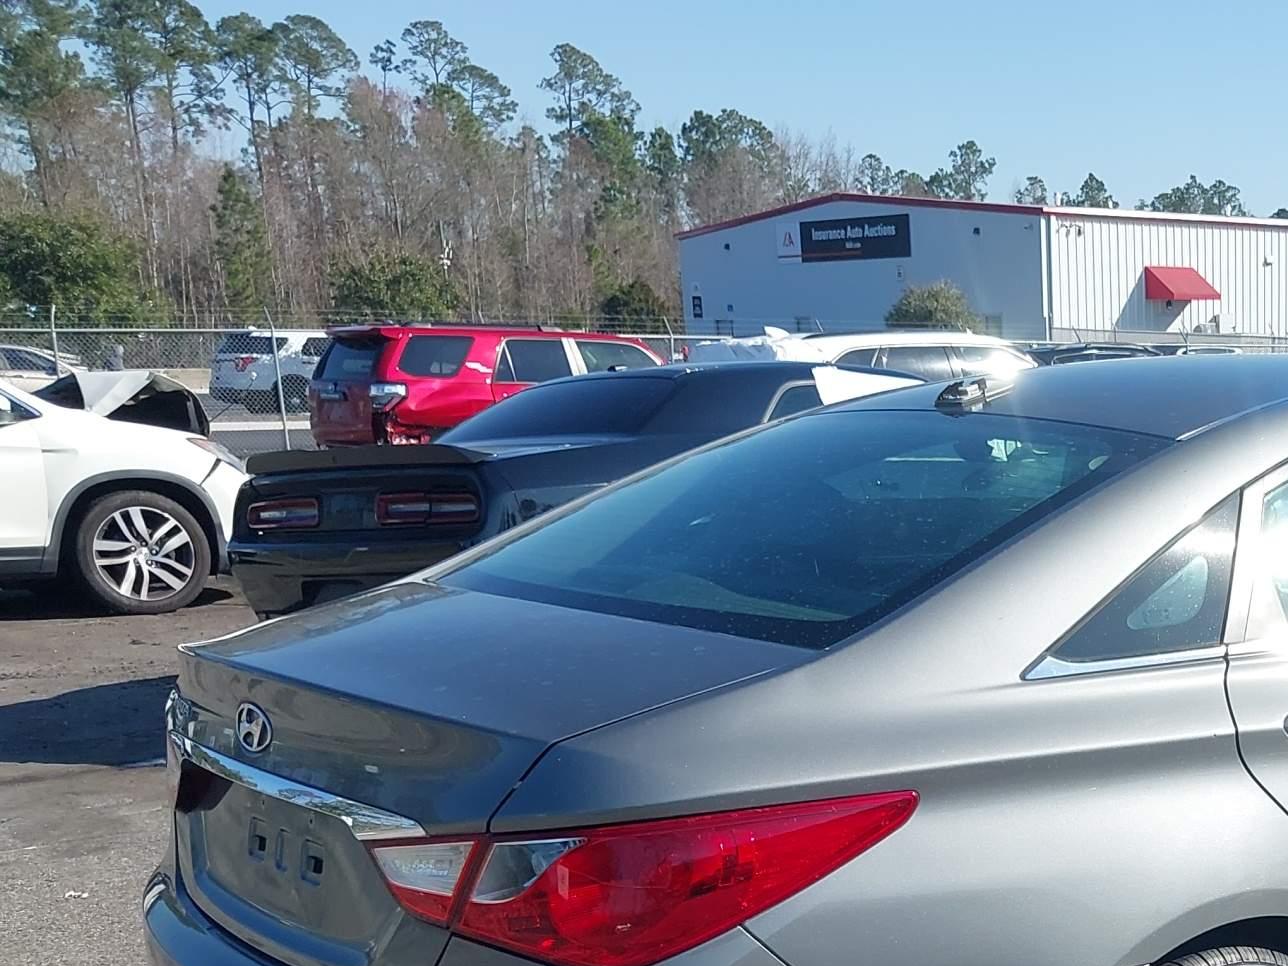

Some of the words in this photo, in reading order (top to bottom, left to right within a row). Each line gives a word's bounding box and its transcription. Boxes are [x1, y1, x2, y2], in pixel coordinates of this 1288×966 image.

[811, 227, 846, 241] Insurance
[847, 225, 862, 239] Auto
[864, 223, 896, 238] Auctions
